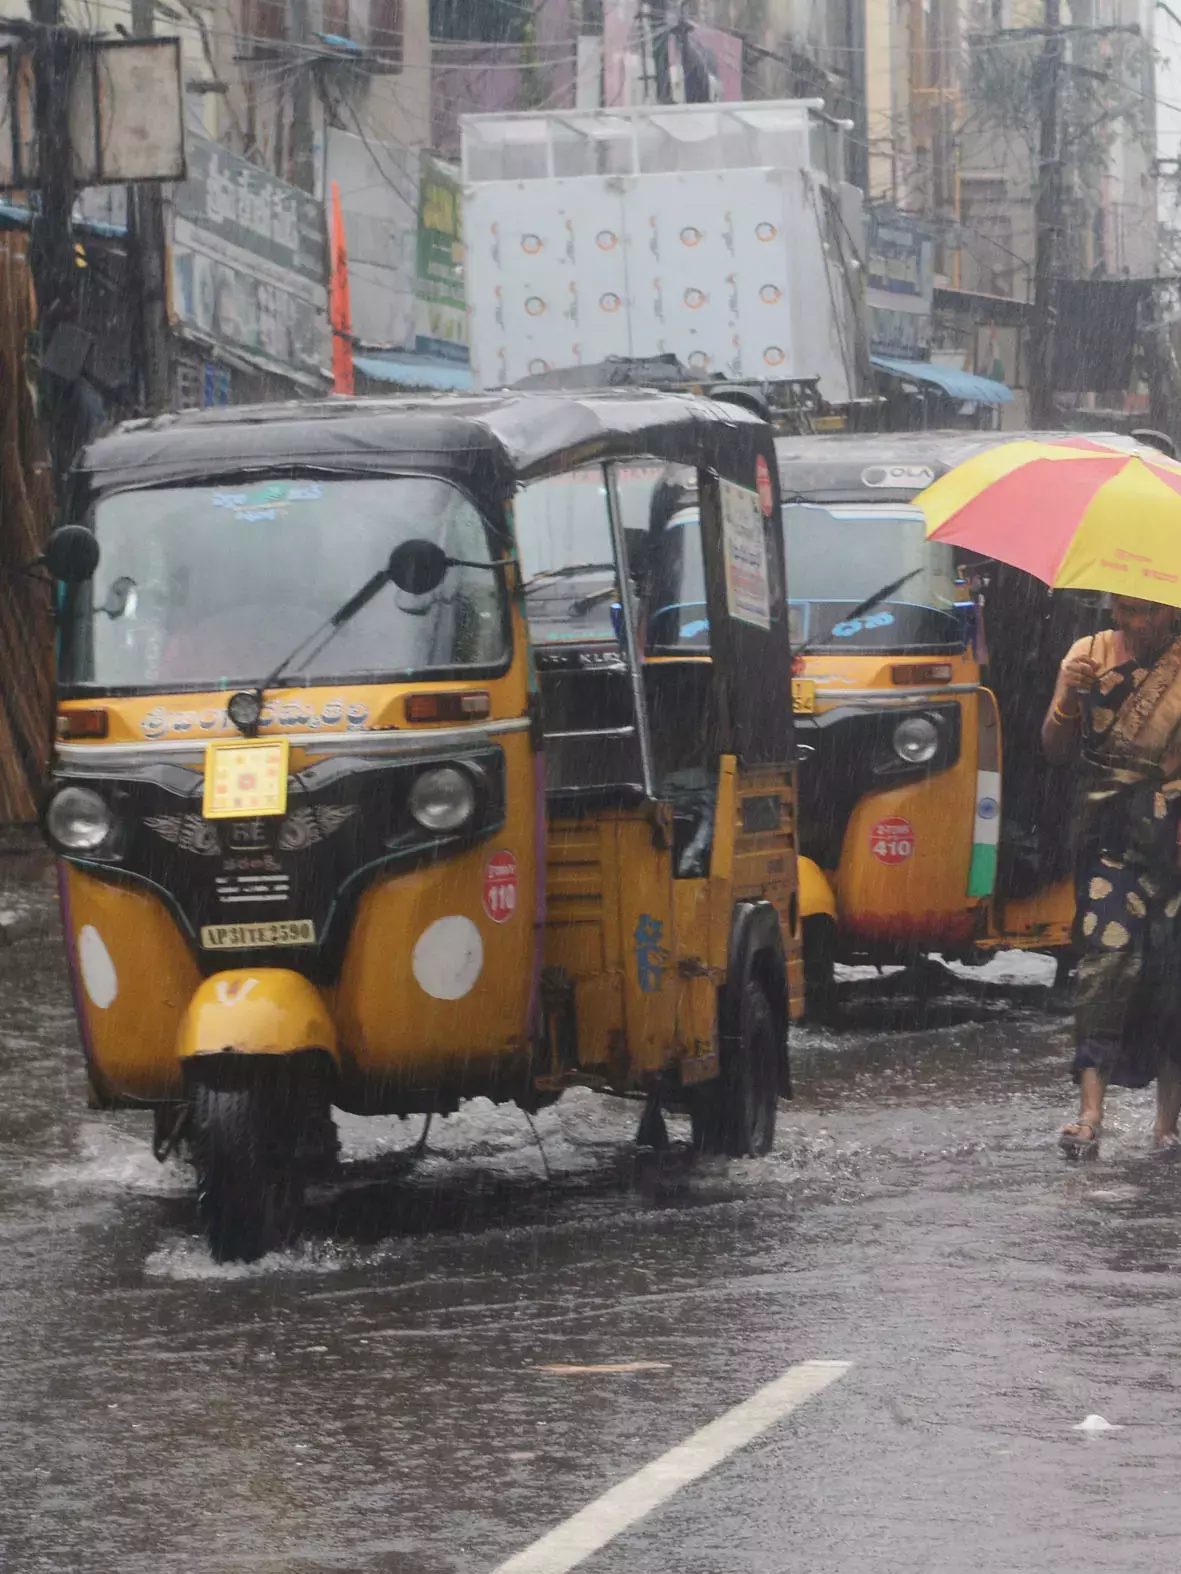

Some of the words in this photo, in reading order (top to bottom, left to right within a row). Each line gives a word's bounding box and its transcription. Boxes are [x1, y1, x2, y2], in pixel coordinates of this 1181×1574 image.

[889, 467, 931, 478] OLA
[232, 822, 266, 841] RE
[873, 840, 912, 857] 410
